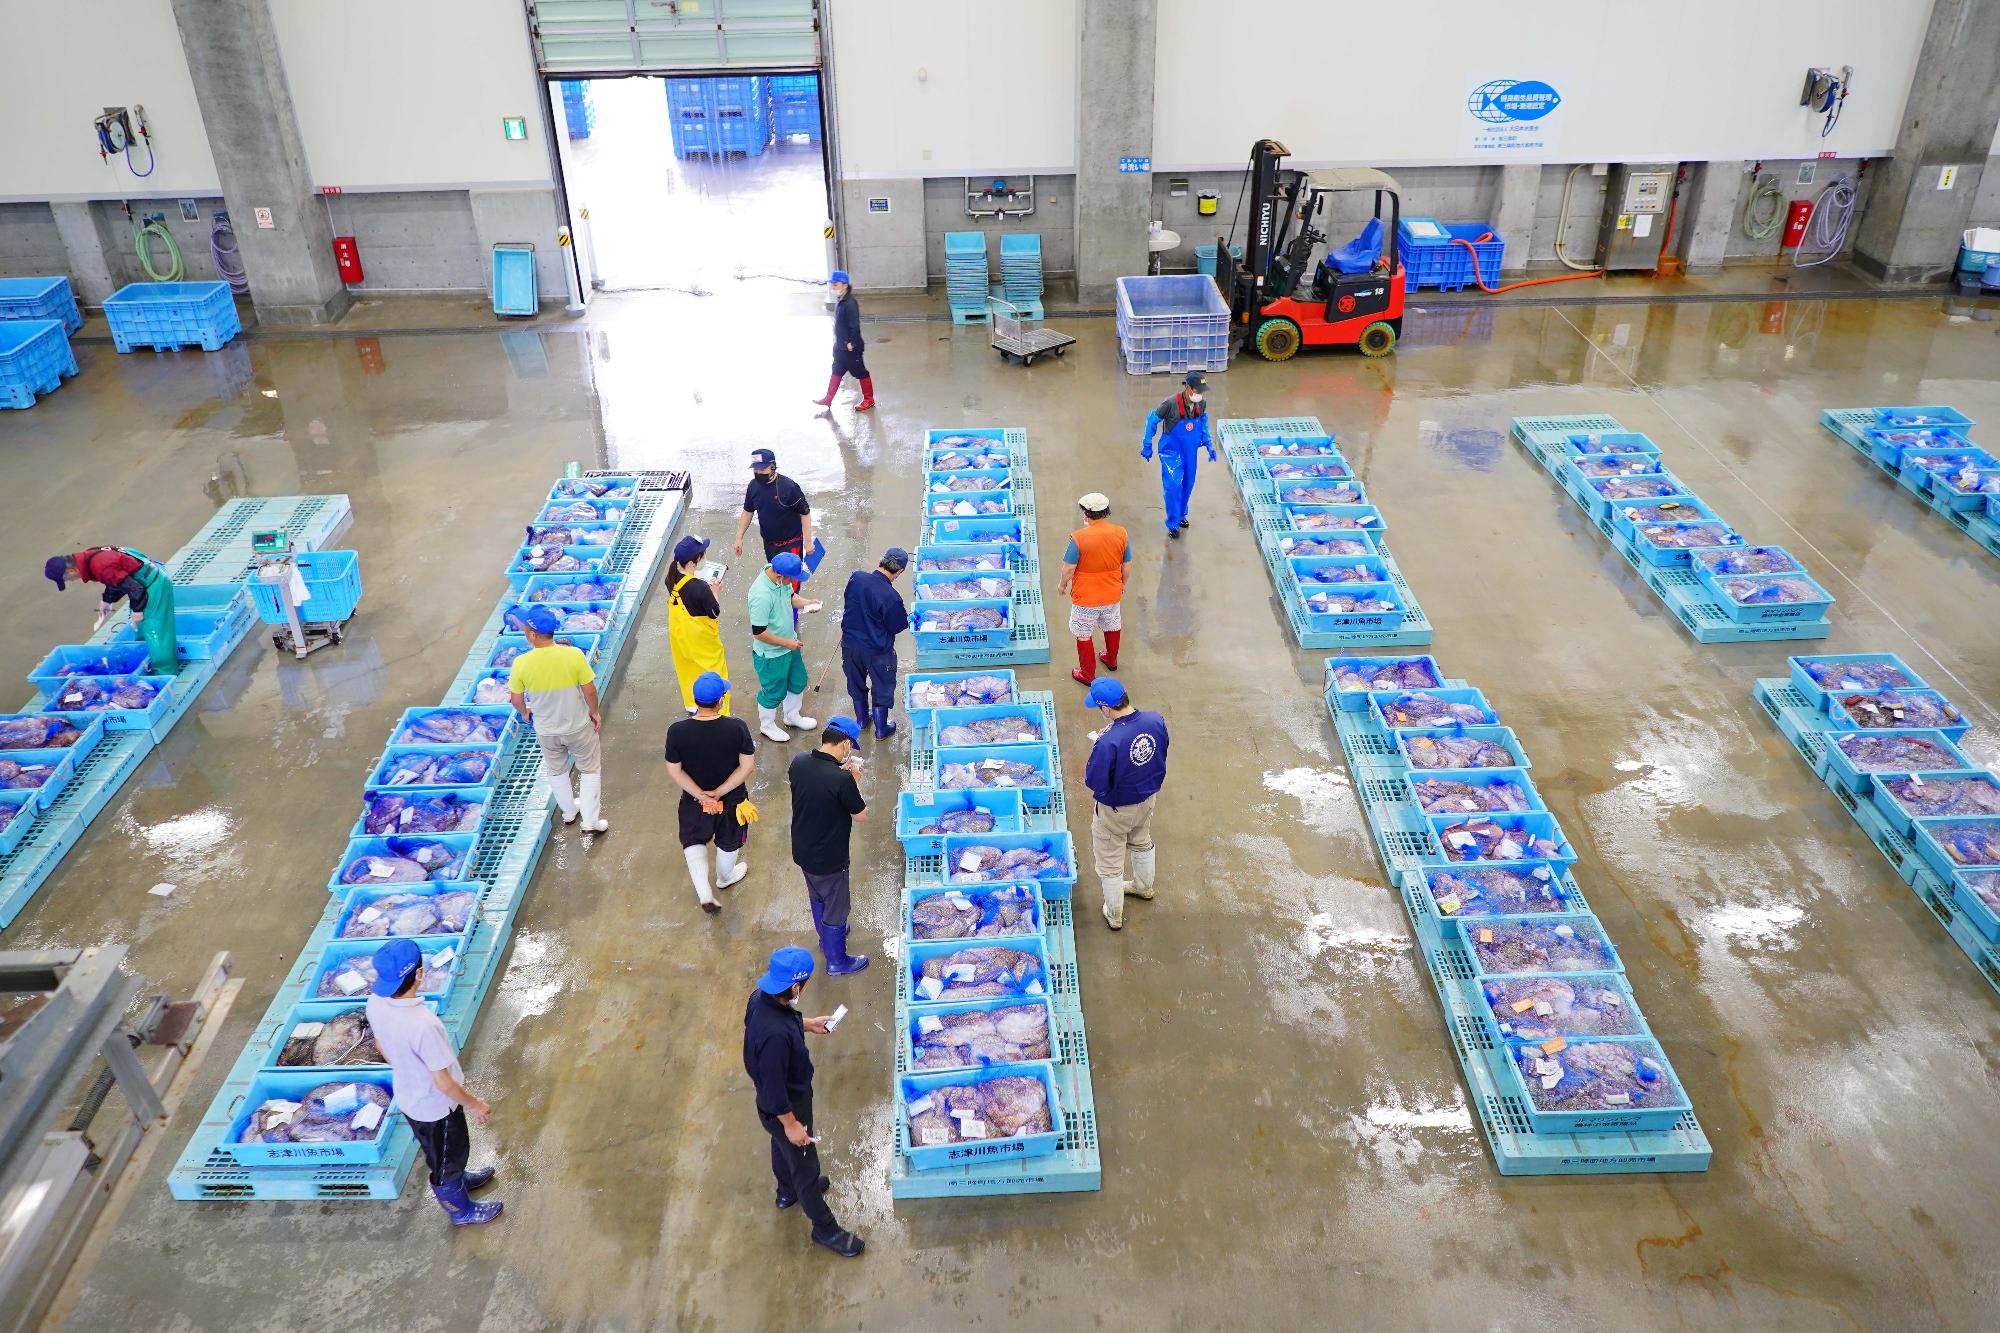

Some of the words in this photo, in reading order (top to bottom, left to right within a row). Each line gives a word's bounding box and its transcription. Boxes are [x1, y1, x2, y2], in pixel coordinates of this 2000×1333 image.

[1259, 202, 1271, 246] NICHIYU
[1374, 287, 1385, 296] 18
[939, 634, 988, 644] 志津川魚市場
[267, 1147, 345, 1158] 志津川魚市場
[948, 1142, 1025, 1160] 志津川魚市場
